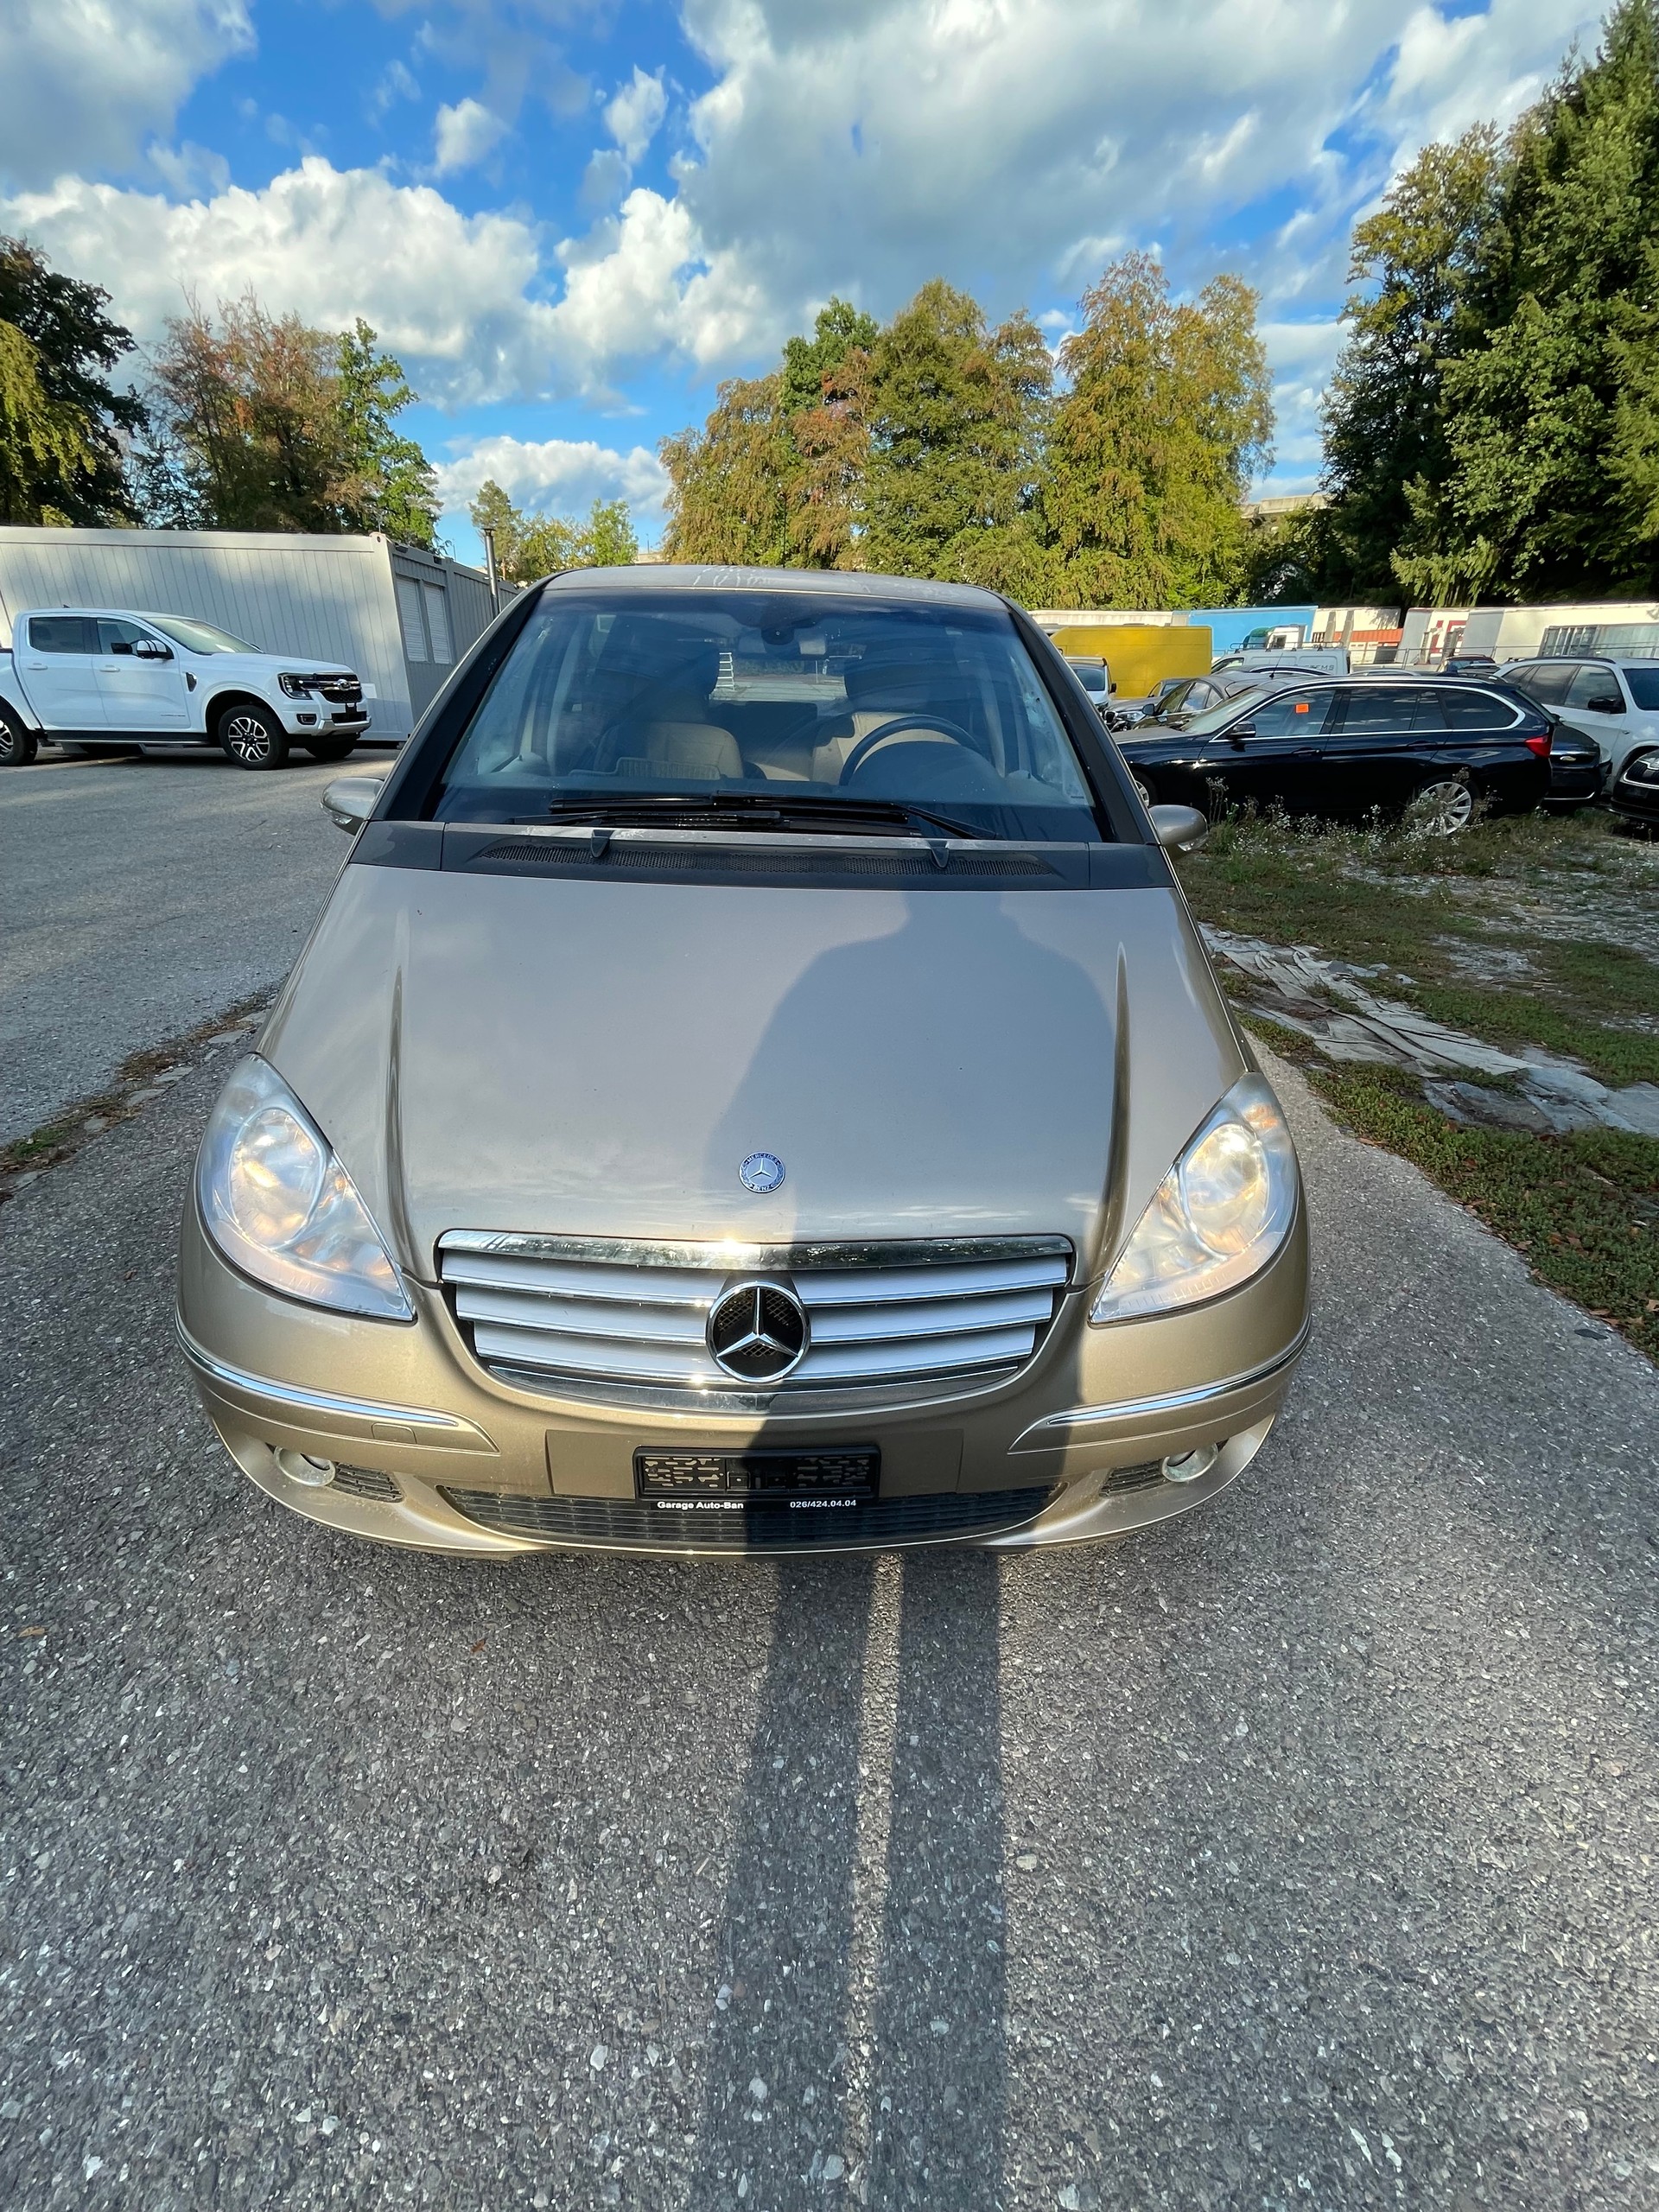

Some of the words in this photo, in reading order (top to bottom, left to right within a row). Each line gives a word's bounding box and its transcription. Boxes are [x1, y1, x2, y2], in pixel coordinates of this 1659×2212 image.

[657, 1501, 694, 1510] Garage
[696, 1501, 744, 1510] Auto-Ban
[790, 1499, 857, 1509] 026/424.04.04
